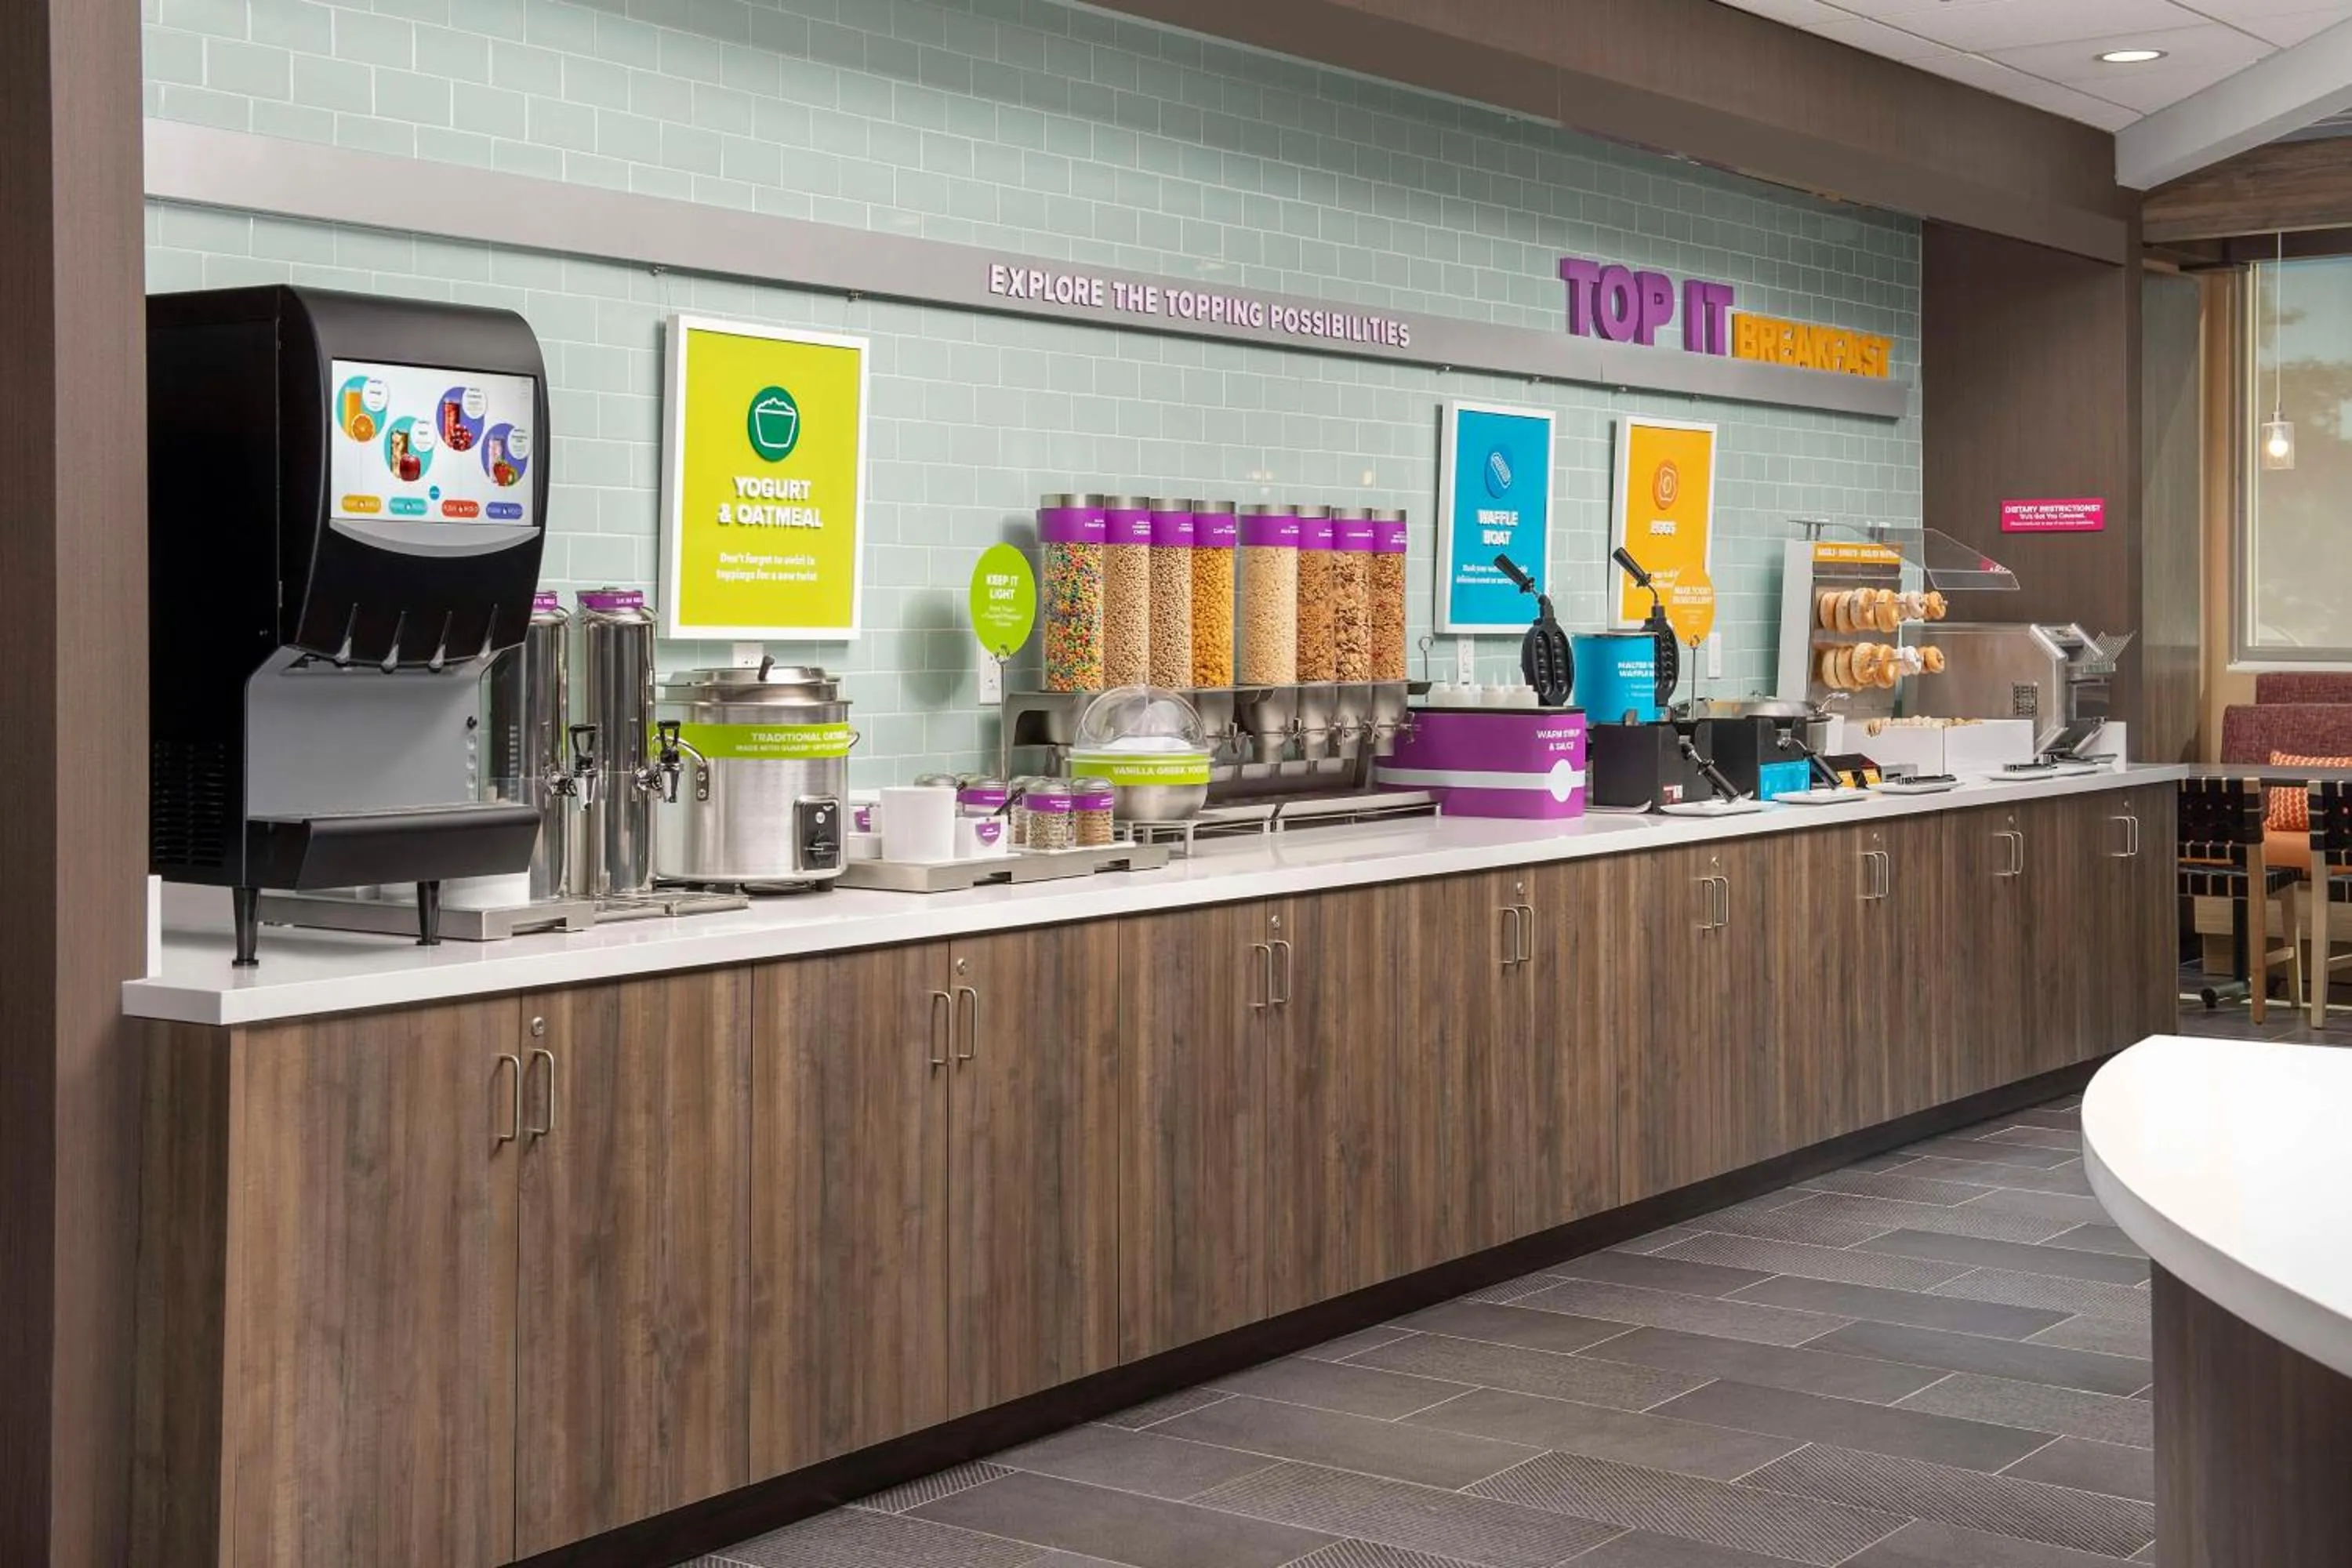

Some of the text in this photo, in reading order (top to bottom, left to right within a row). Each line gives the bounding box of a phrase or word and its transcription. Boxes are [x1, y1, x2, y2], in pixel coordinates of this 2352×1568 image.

[989, 263, 1410, 348] EXPLORE THE TOPPING POSSIBILITIES
[1560, 257, 1894, 378] TOP IT BREAKFAST
[732, 476, 811, 501] YOGURT
[716, 503, 823, 528] & OATMEAL
[1477, 509, 1519, 526] WAFFLE
[1483, 529, 1512, 546] BOAT
[986, 574, 1018, 587] KEEP IT
[989, 588, 1015, 601] LIGHT
[751, 731, 822, 742] TRADITIONAL
[1537, 729, 1563, 739] WARM
[1112, 765, 1156, 776] VANILLA
